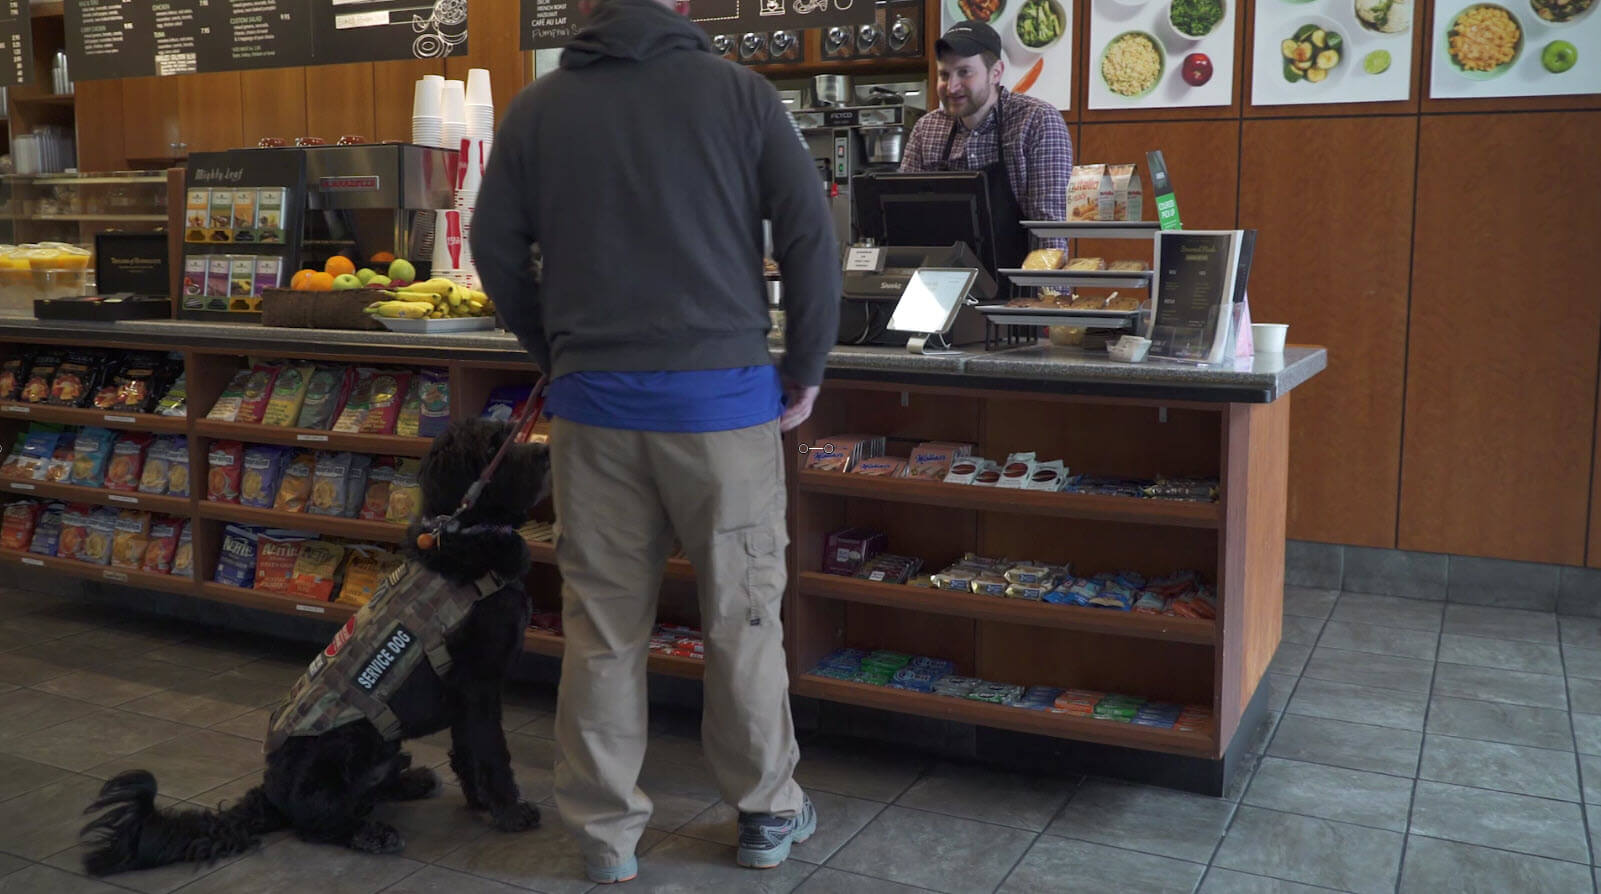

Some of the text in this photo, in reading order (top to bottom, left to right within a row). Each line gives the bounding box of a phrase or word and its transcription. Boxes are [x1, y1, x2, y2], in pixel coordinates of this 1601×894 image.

[195, 168, 243, 182] Mighty Leaf
[358, 630, 411, 689] SERVICE DOG
